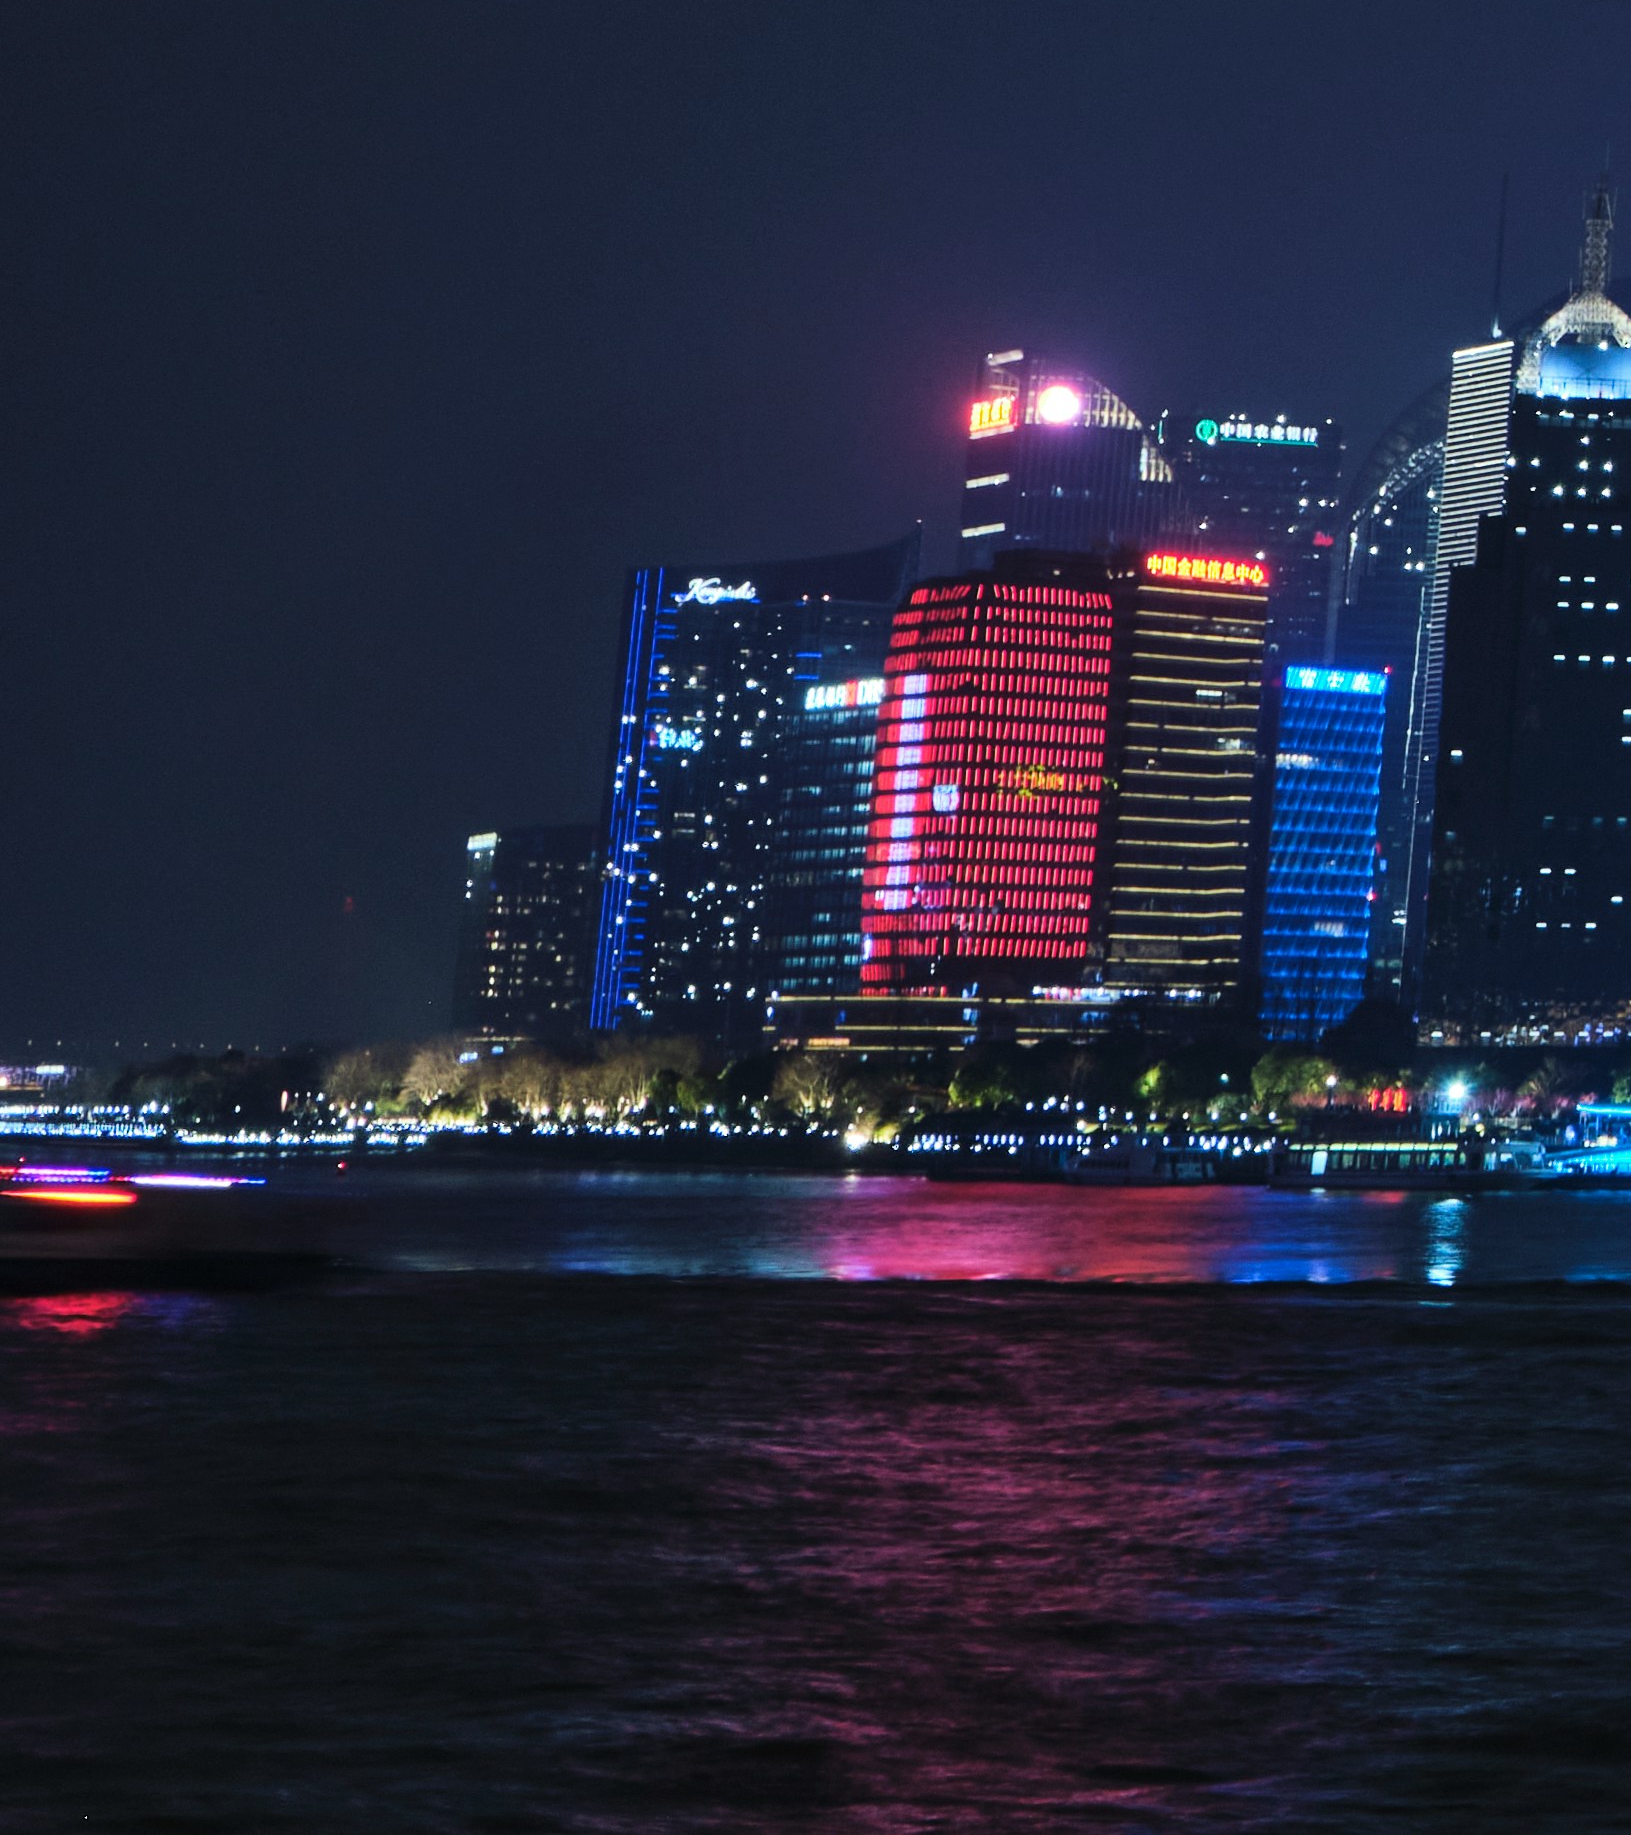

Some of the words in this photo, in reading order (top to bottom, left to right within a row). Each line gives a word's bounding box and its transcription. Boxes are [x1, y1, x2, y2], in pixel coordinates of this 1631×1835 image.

[1147, 554, 1265, 584] 中国金融信息中心
